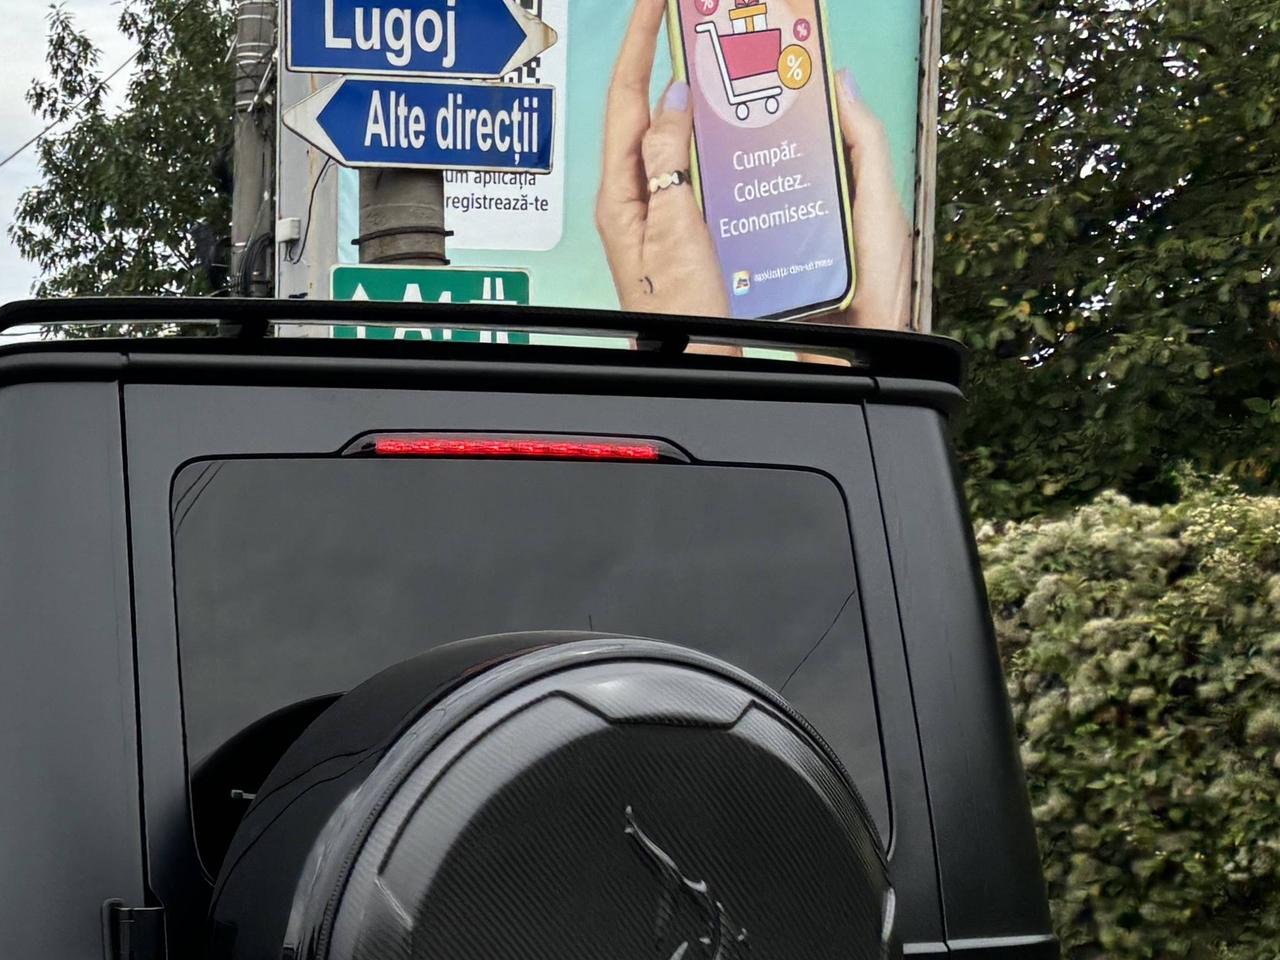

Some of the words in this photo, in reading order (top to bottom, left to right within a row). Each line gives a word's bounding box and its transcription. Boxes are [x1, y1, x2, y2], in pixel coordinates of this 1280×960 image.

[324, 0, 456, 68] Lugoj
[364, 90, 426, 149] Alte
[436, 93, 538, 165] direcții
[733, 141, 802, 171] Cumpăr.
[719, 201, 829, 238] Economisesc.
